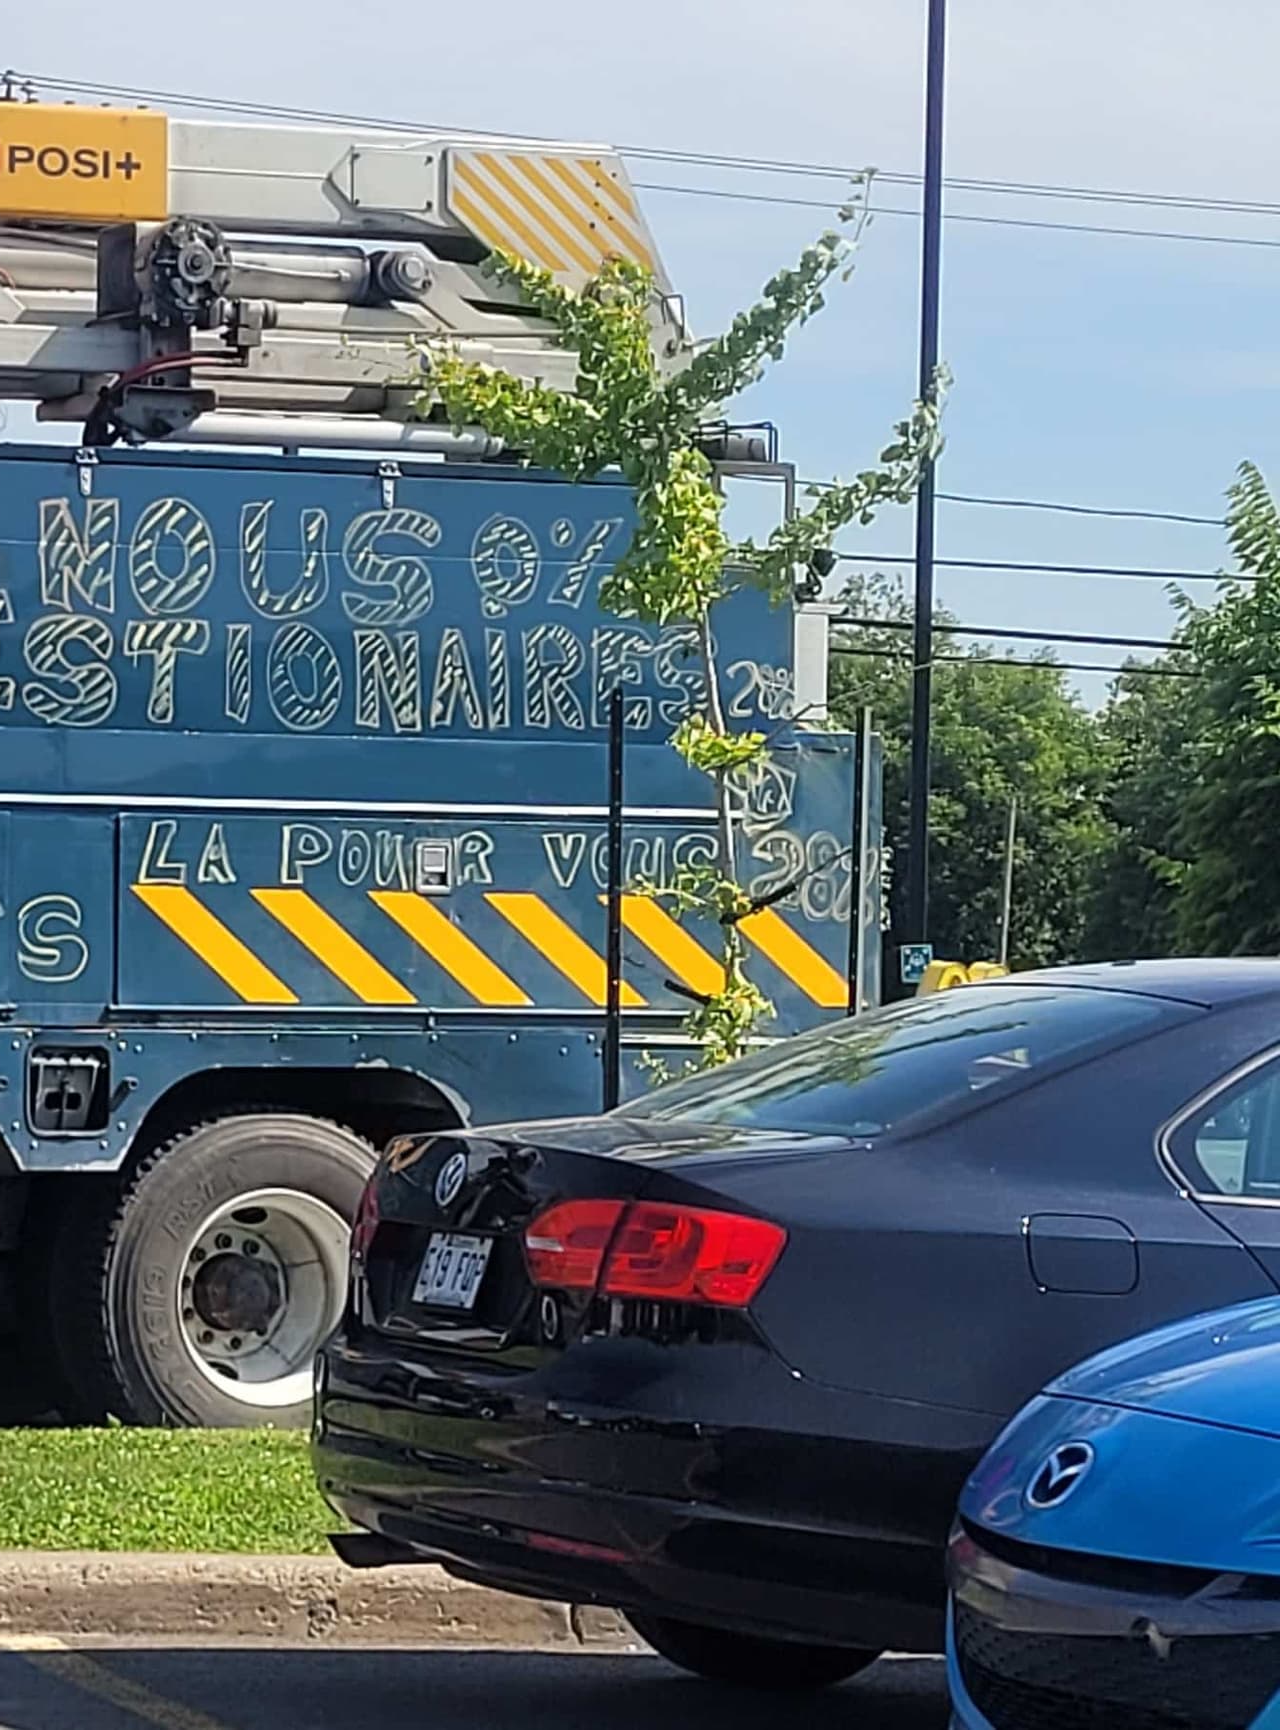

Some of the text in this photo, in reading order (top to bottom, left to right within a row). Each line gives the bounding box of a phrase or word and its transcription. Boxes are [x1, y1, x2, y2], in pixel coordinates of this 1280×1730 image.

[8, 145, 141, 180] POSI+
[39, 497, 442, 625] NOUS
[141, 820, 236, 885] LA
